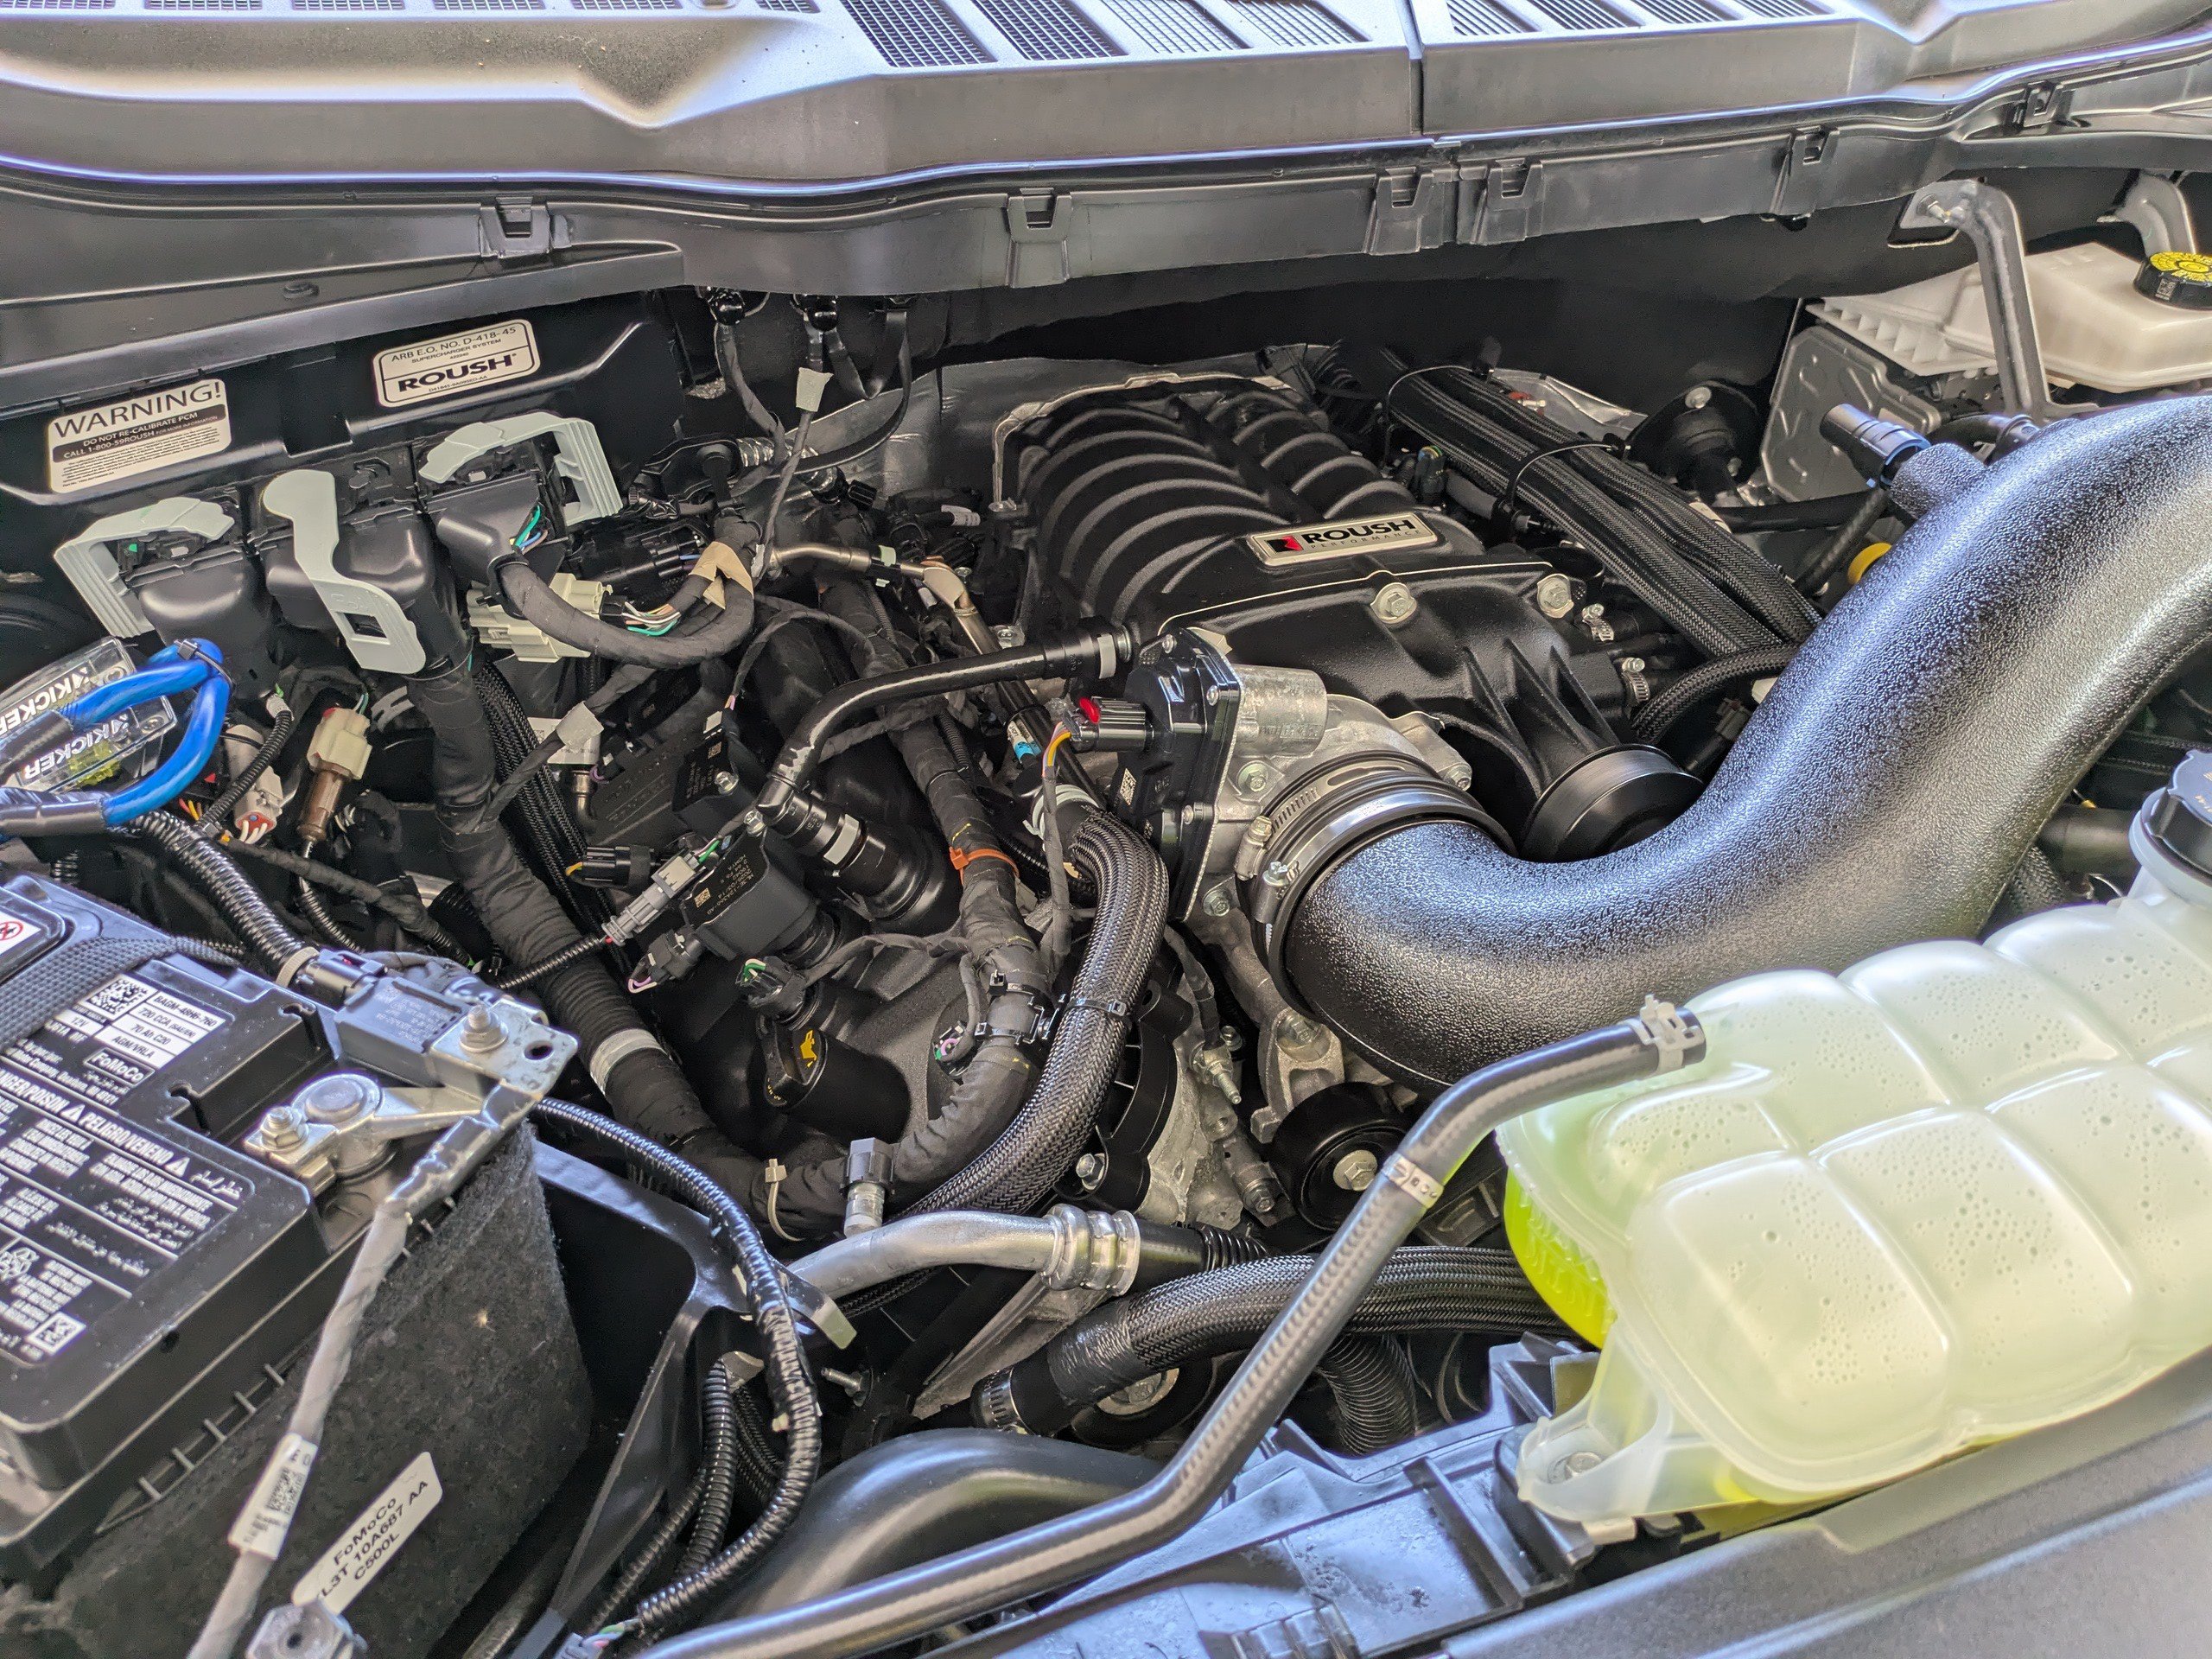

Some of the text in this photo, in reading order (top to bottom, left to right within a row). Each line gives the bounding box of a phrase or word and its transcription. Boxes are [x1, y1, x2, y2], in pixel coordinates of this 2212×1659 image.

[391, 351, 414, 362] ARB
[416, 346, 438, 355] E.O.
[441, 340, 461, 350] NO.
[411, 338, 501, 364] SUPERCHARGER SYSTEM
[397, 354, 512, 392] ROUSH
[54, 382, 221, 438] WARNING!
[83, 412, 199, 447] DO NOT RE-CALIBRATE PCM
[63, 448, 86, 460] CALL
[87, 431, 155, 454] 1-800-59ROUSH
[1301, 519, 1416, 544] ROUSH
[1311, 529, 1421, 549] PERFORMANCE
[24, 722, 110, 779] KICKER
[71, 1016, 89, 1028] 12V
[130, 1023, 143, 1034] 70
[137, 1007, 156, 1019] 720
[155, 1014, 171, 1027] CCA
[112, 1036, 156, 1059] AGM/VRLA
[91, 1052, 145, 1082] FoMoCo
[0, 1069, 71, 1114] NGER/POISON
[78, 1111, 175, 1166] PELIGRO/VENENO
[321, 1481, 429, 1597] L3T 10A687 AA
[333, 1497, 397, 1566] FoMoCo
[353, 1533, 400, 1580] C500L
